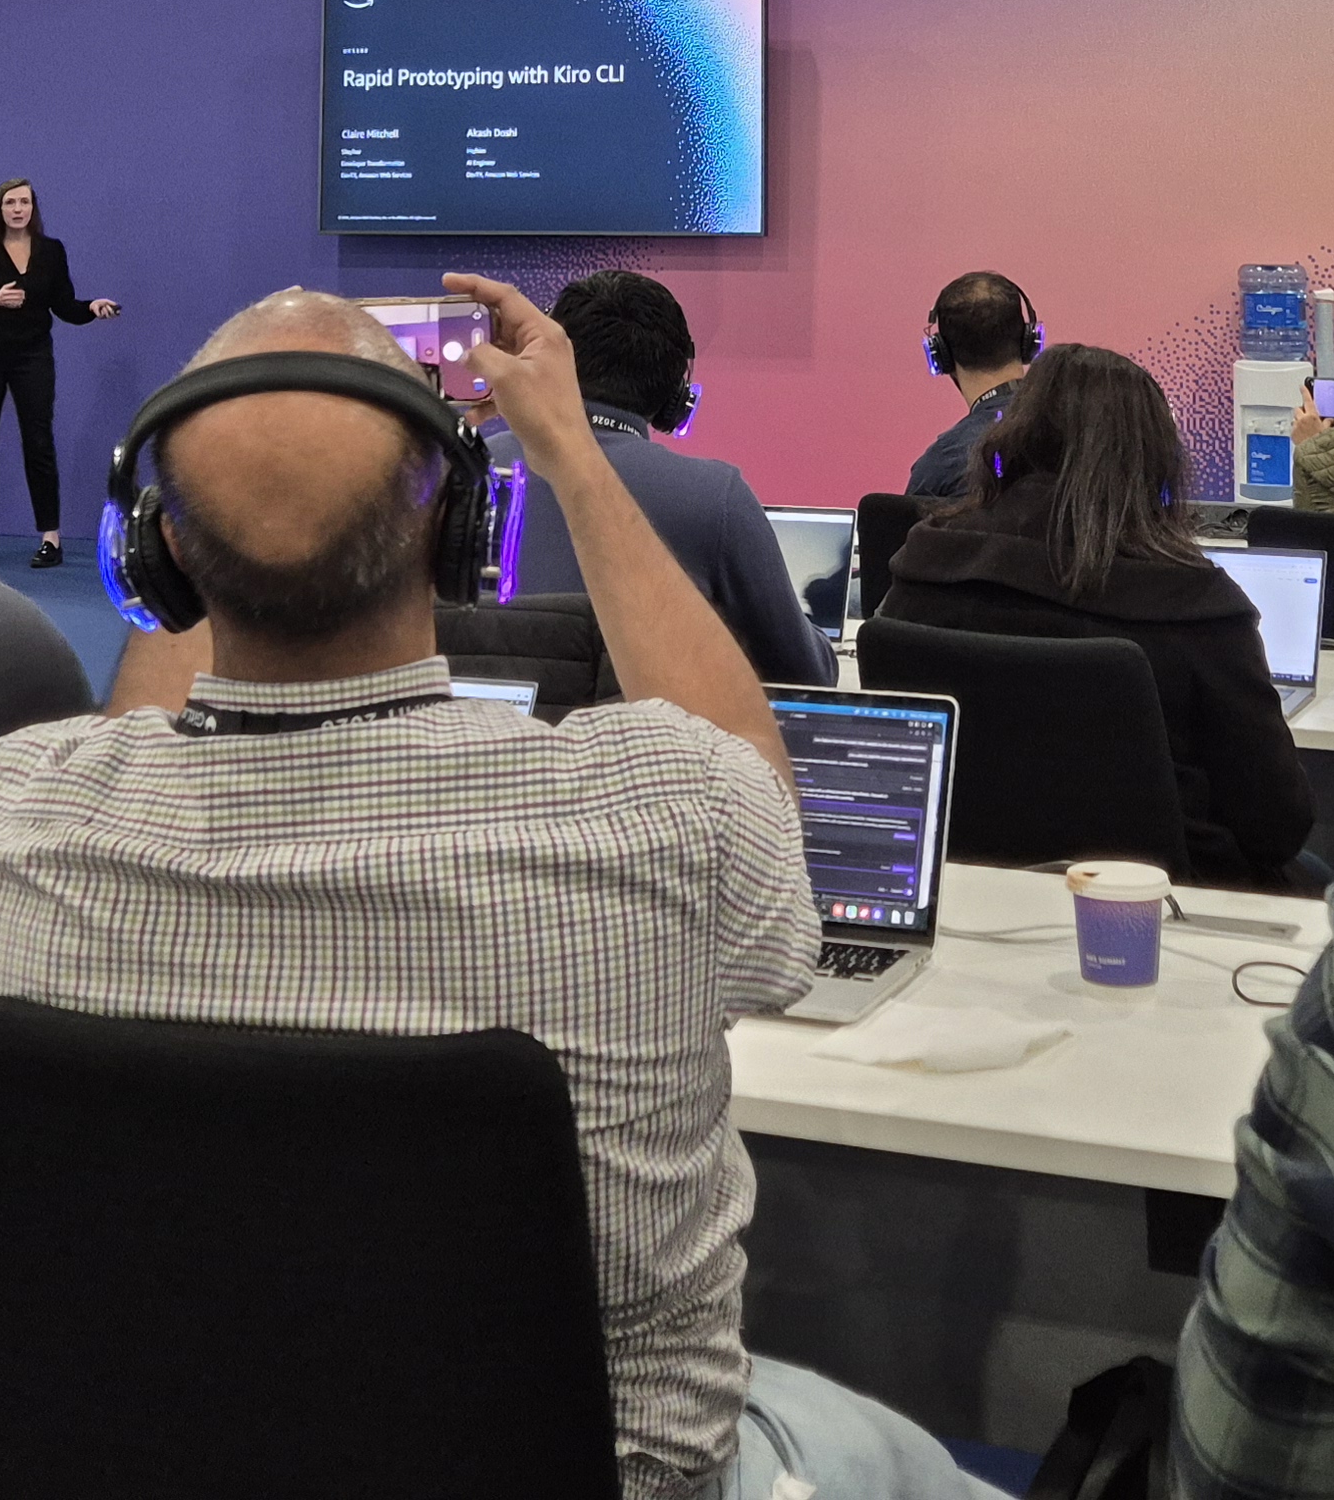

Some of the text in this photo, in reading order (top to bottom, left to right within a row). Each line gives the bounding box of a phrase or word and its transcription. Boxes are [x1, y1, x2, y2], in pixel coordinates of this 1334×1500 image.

[343, 64, 625, 90] Rapid Prototyping with Kiro CLI
[341, 129, 399, 139] Claire Mitchell
[466, 127, 518, 138] Akash Doshi
[592, 415, 616, 428] 2026
